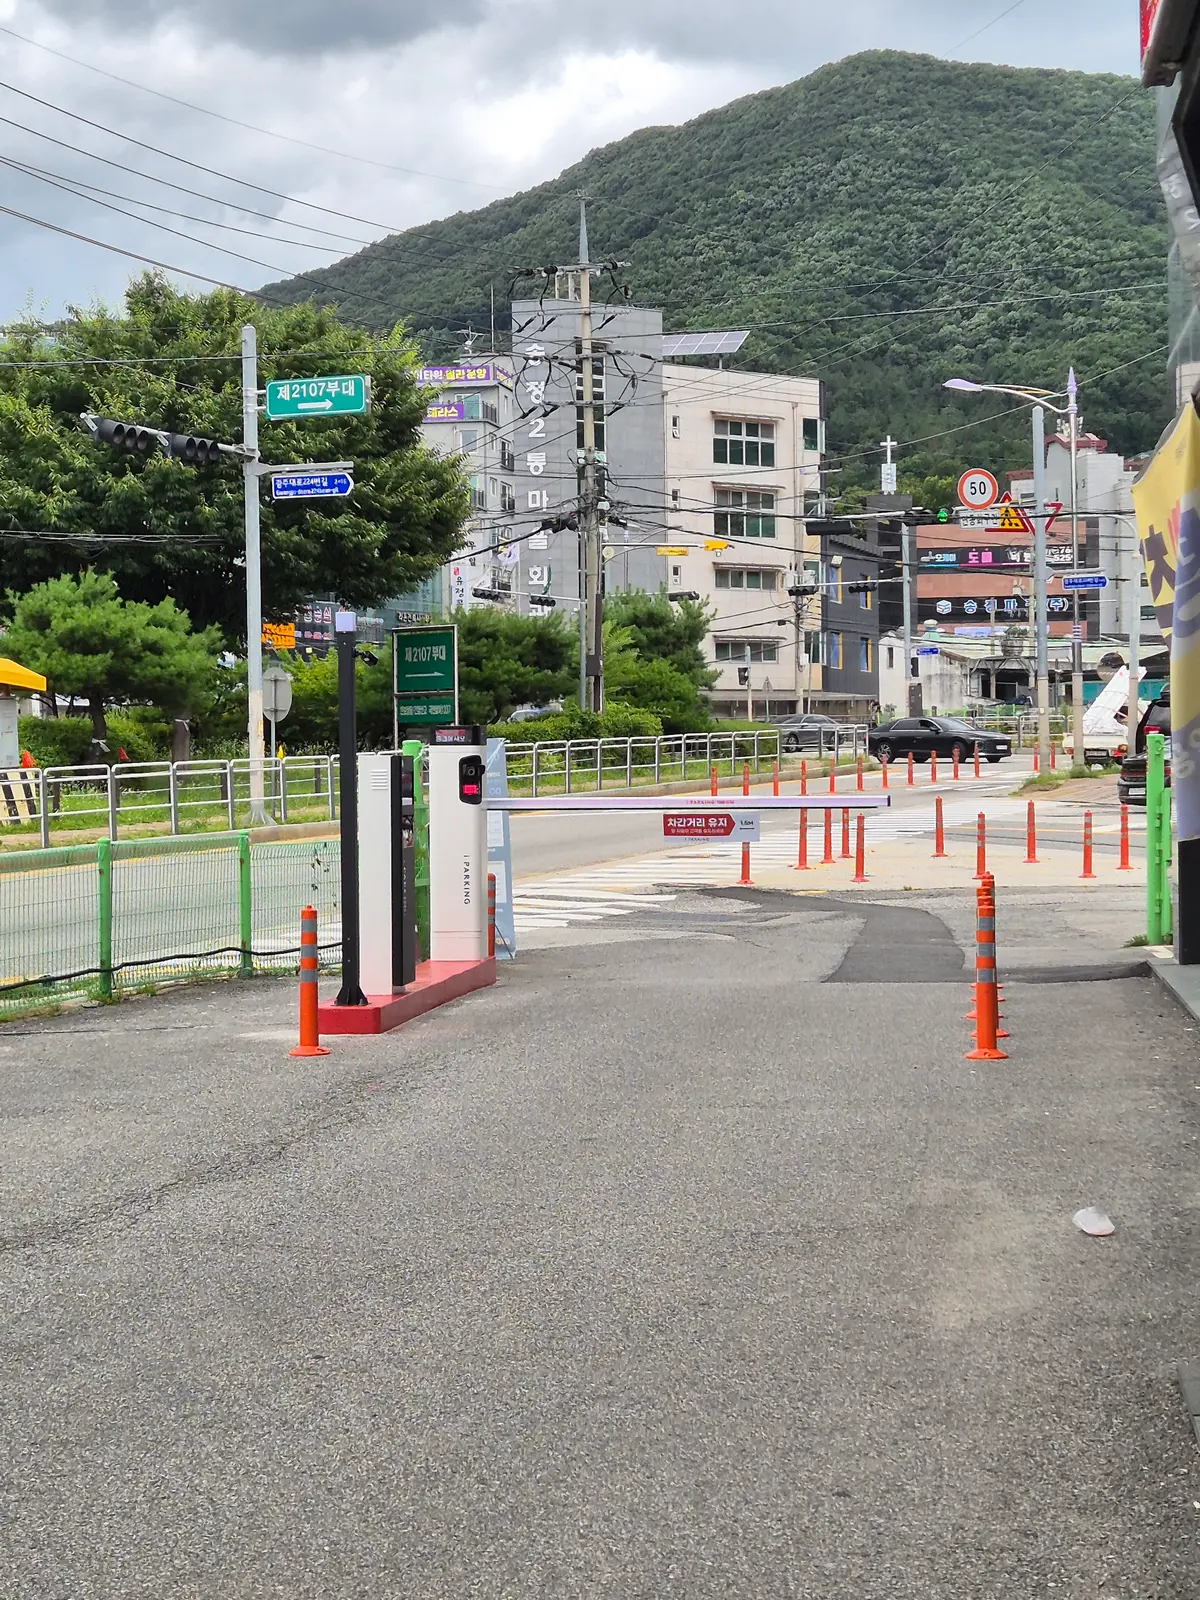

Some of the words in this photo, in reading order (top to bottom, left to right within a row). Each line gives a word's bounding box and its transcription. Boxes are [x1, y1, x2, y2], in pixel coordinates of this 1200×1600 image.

[276, 380, 355, 401] 제2107부대
[970, 481, 987, 496] 50
[405, 645, 446, 662] 제2107부대
[667, 817, 705, 827] 차간거리
[708, 817, 728, 827] 유지
